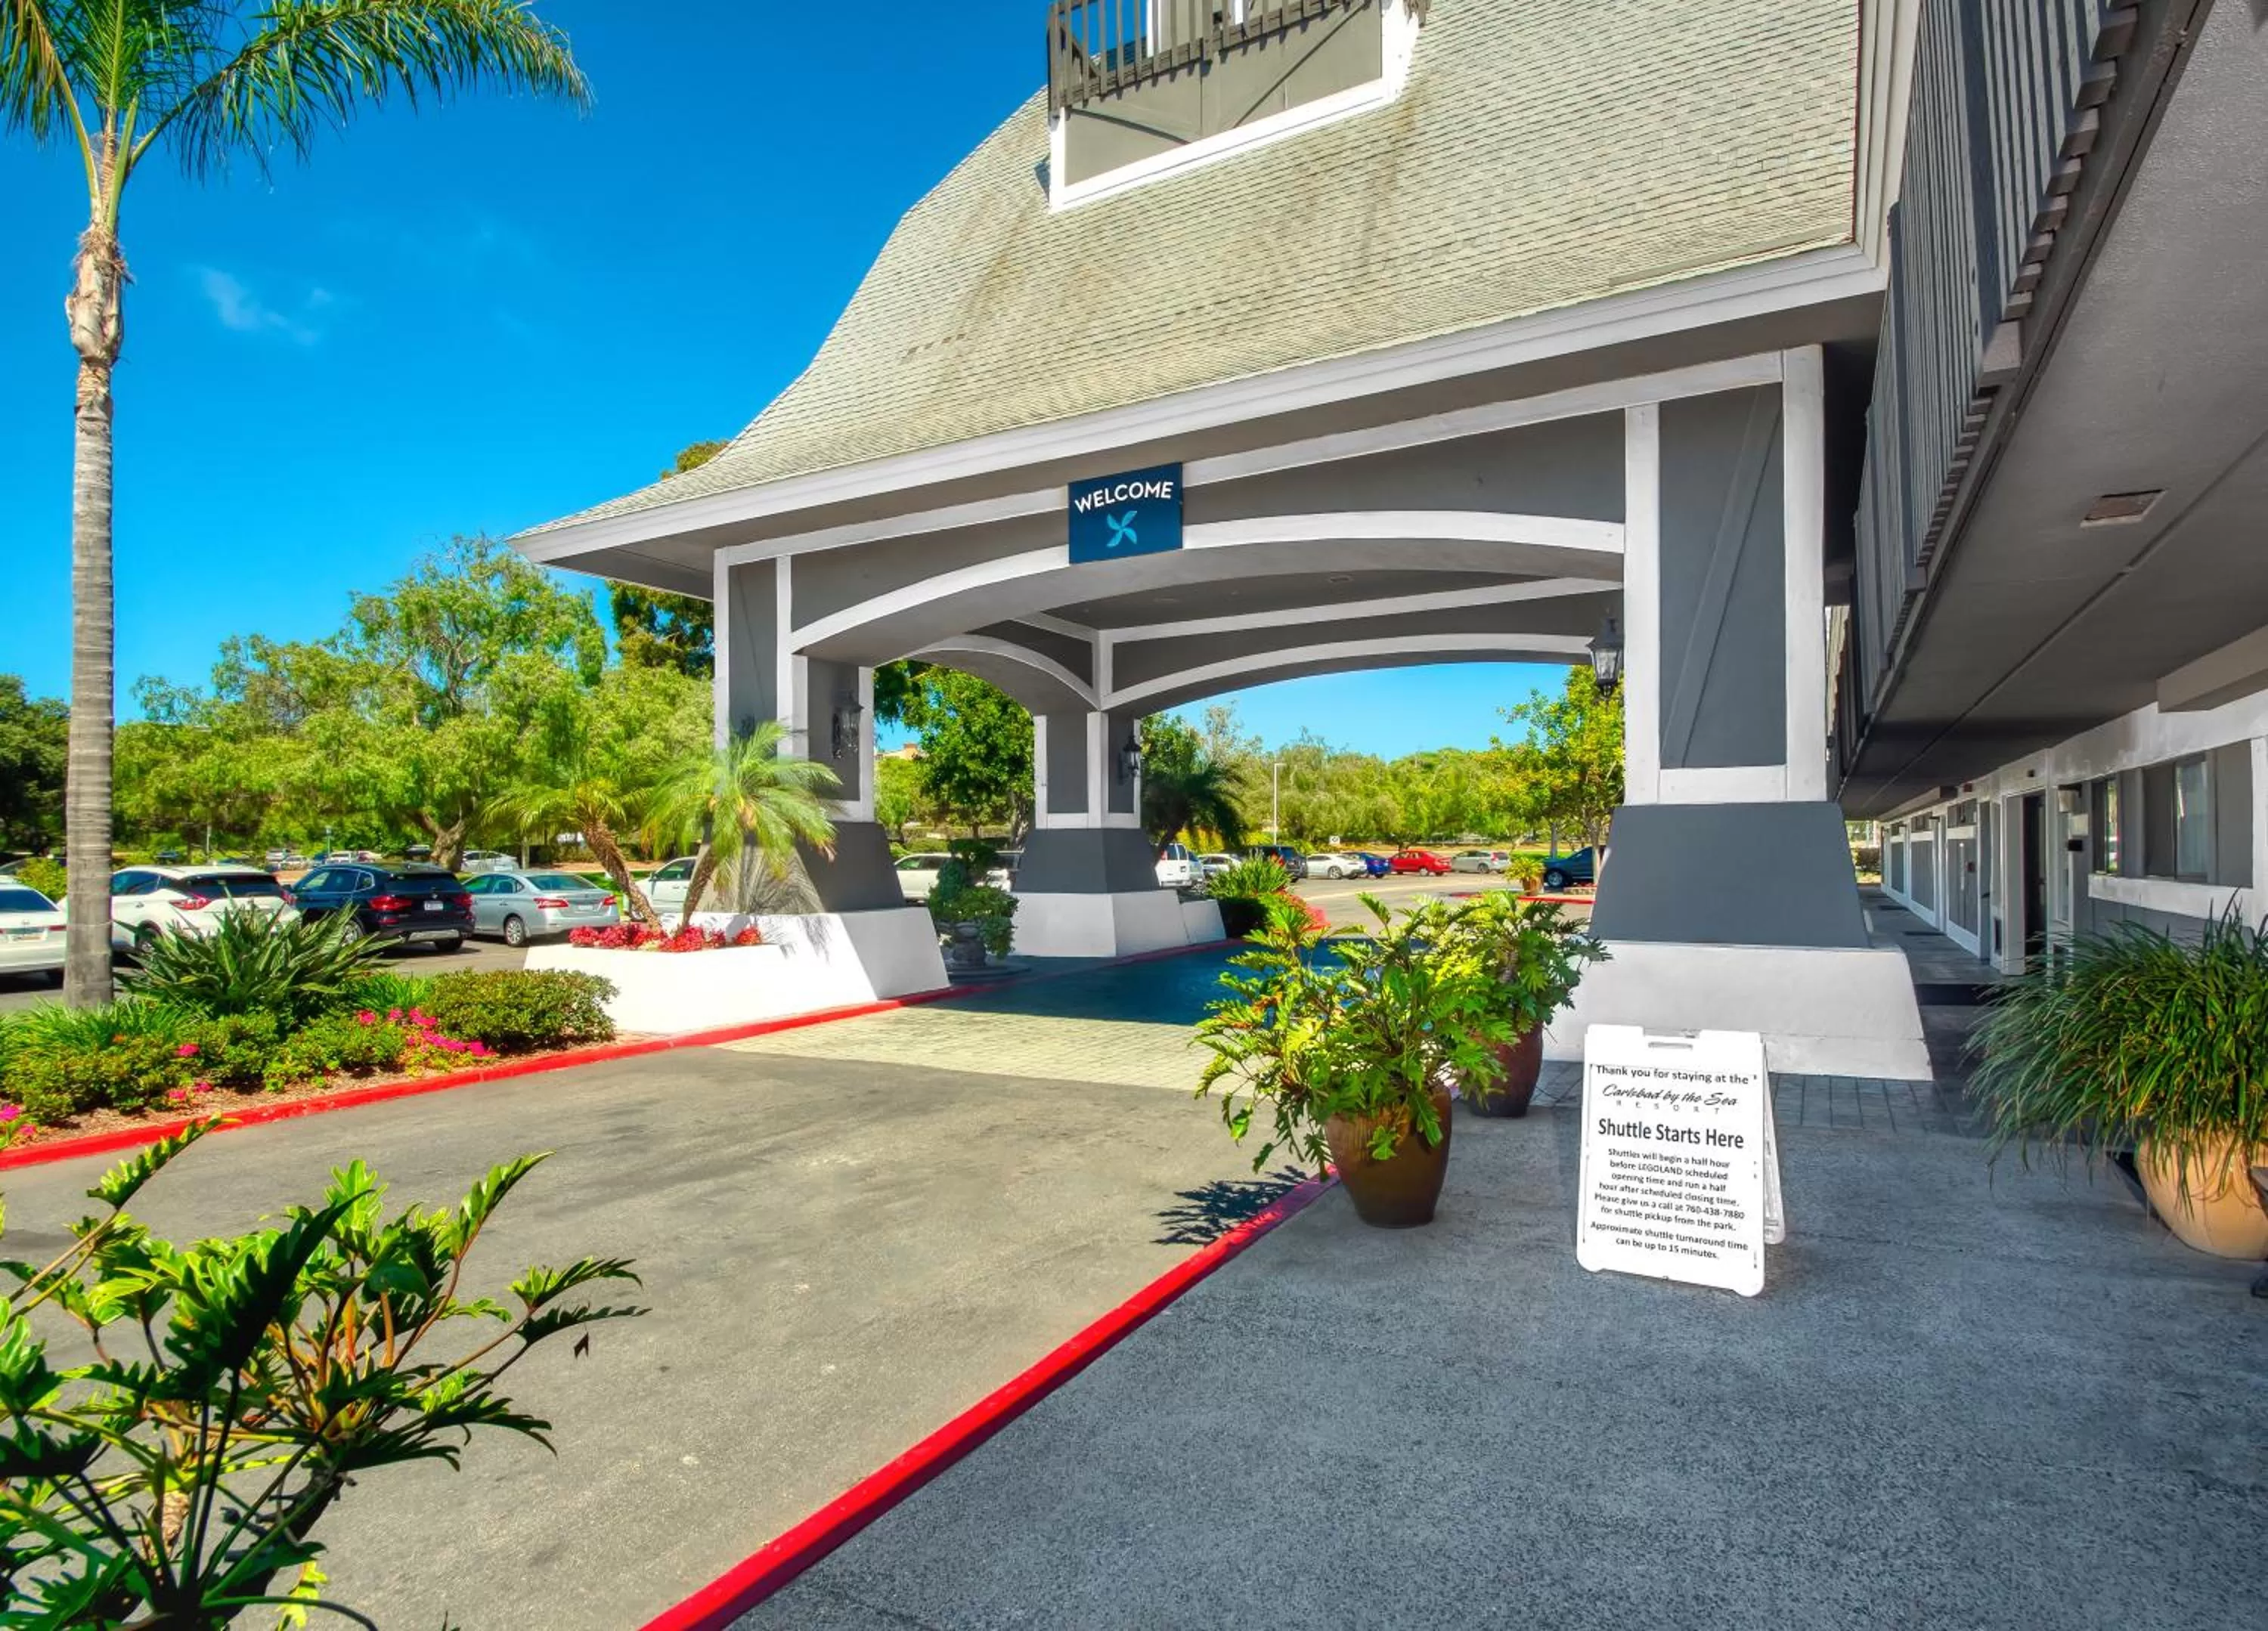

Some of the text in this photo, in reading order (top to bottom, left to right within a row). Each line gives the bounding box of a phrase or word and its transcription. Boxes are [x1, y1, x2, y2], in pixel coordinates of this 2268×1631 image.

[1074, 481, 1173, 513] WELCOME
[1597, 1065, 1627, 1075] Thank
[1654, 1068, 1669, 1078] for
[1672, 1072, 1712, 1084] staying
[1730, 1073, 1748, 1084] the
[1603, 1083, 1738, 1106] Carlsbad by the Sea
[1598, 1118, 1744, 1149] Shuttle Starts Here
[1608, 1149, 1640, 1158] Shuttles
[1659, 1153, 1681, 1164] begin
[1692, 1156, 1708, 1165] half
[1710, 1158, 1730, 1168] hour
[1610, 1159, 1728, 1179] before LEGOLAND scheduled
[1600, 1181, 1617, 1190] hour
[1619, 1185, 1639, 1193] after
[1641, 1188, 1682, 1199] scheduled
[1684, 1193, 1714, 1205] closing
[1612, 1173, 1644, 1184] opening
[1647, 1176, 1665, 1185] time
[1709, 1183, 1726, 1192] half
[1594, 1192, 1619, 1203] Please
[1621, 1197, 1637, 1205] give
[1686, 1205, 1745, 1219] 760-438-7880
[1601, 1205, 1736, 1230] for shuttle pickup from the park.
[1591, 1221, 1748, 1250] Approximate shuttle turnaround time
[1616, 1238, 1630, 1246] can
[1632, 1239, 1643, 1247] be
[1645, 1242, 1656, 1251] up
[1669, 1244, 1679, 1252] 15
